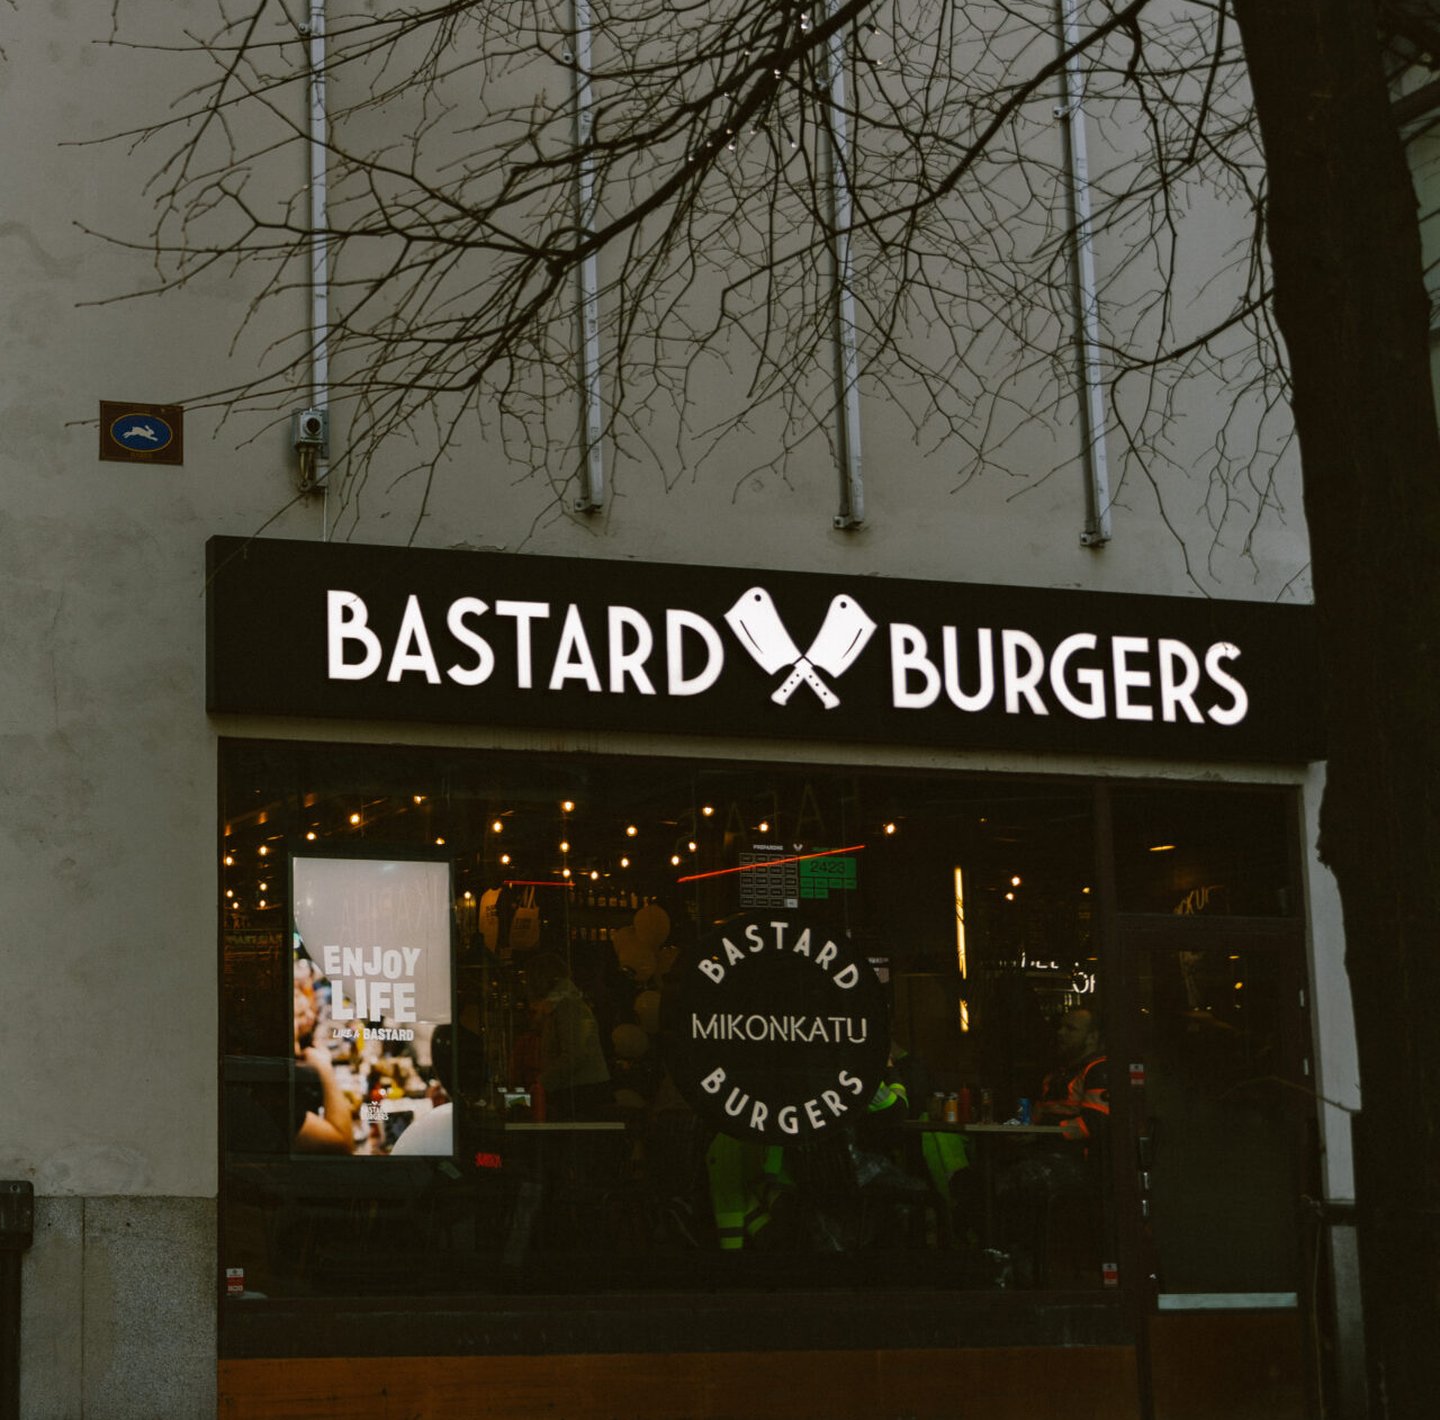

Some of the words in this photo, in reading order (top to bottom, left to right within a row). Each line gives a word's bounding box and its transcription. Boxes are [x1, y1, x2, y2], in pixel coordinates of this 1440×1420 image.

[327, 590, 725, 696] BASTARD
[889, 622, 1249, 726] BURGERS
[323, 945, 422, 980] ENJOY
[698, 921, 859, 990] BASTARD
[331, 978, 417, 1023] LIFE
[363, 1028, 414, 1041] BASTARD
[692, 1013, 867, 1043] MIKONKATU
[700, 1067, 863, 1134] BURGERS
